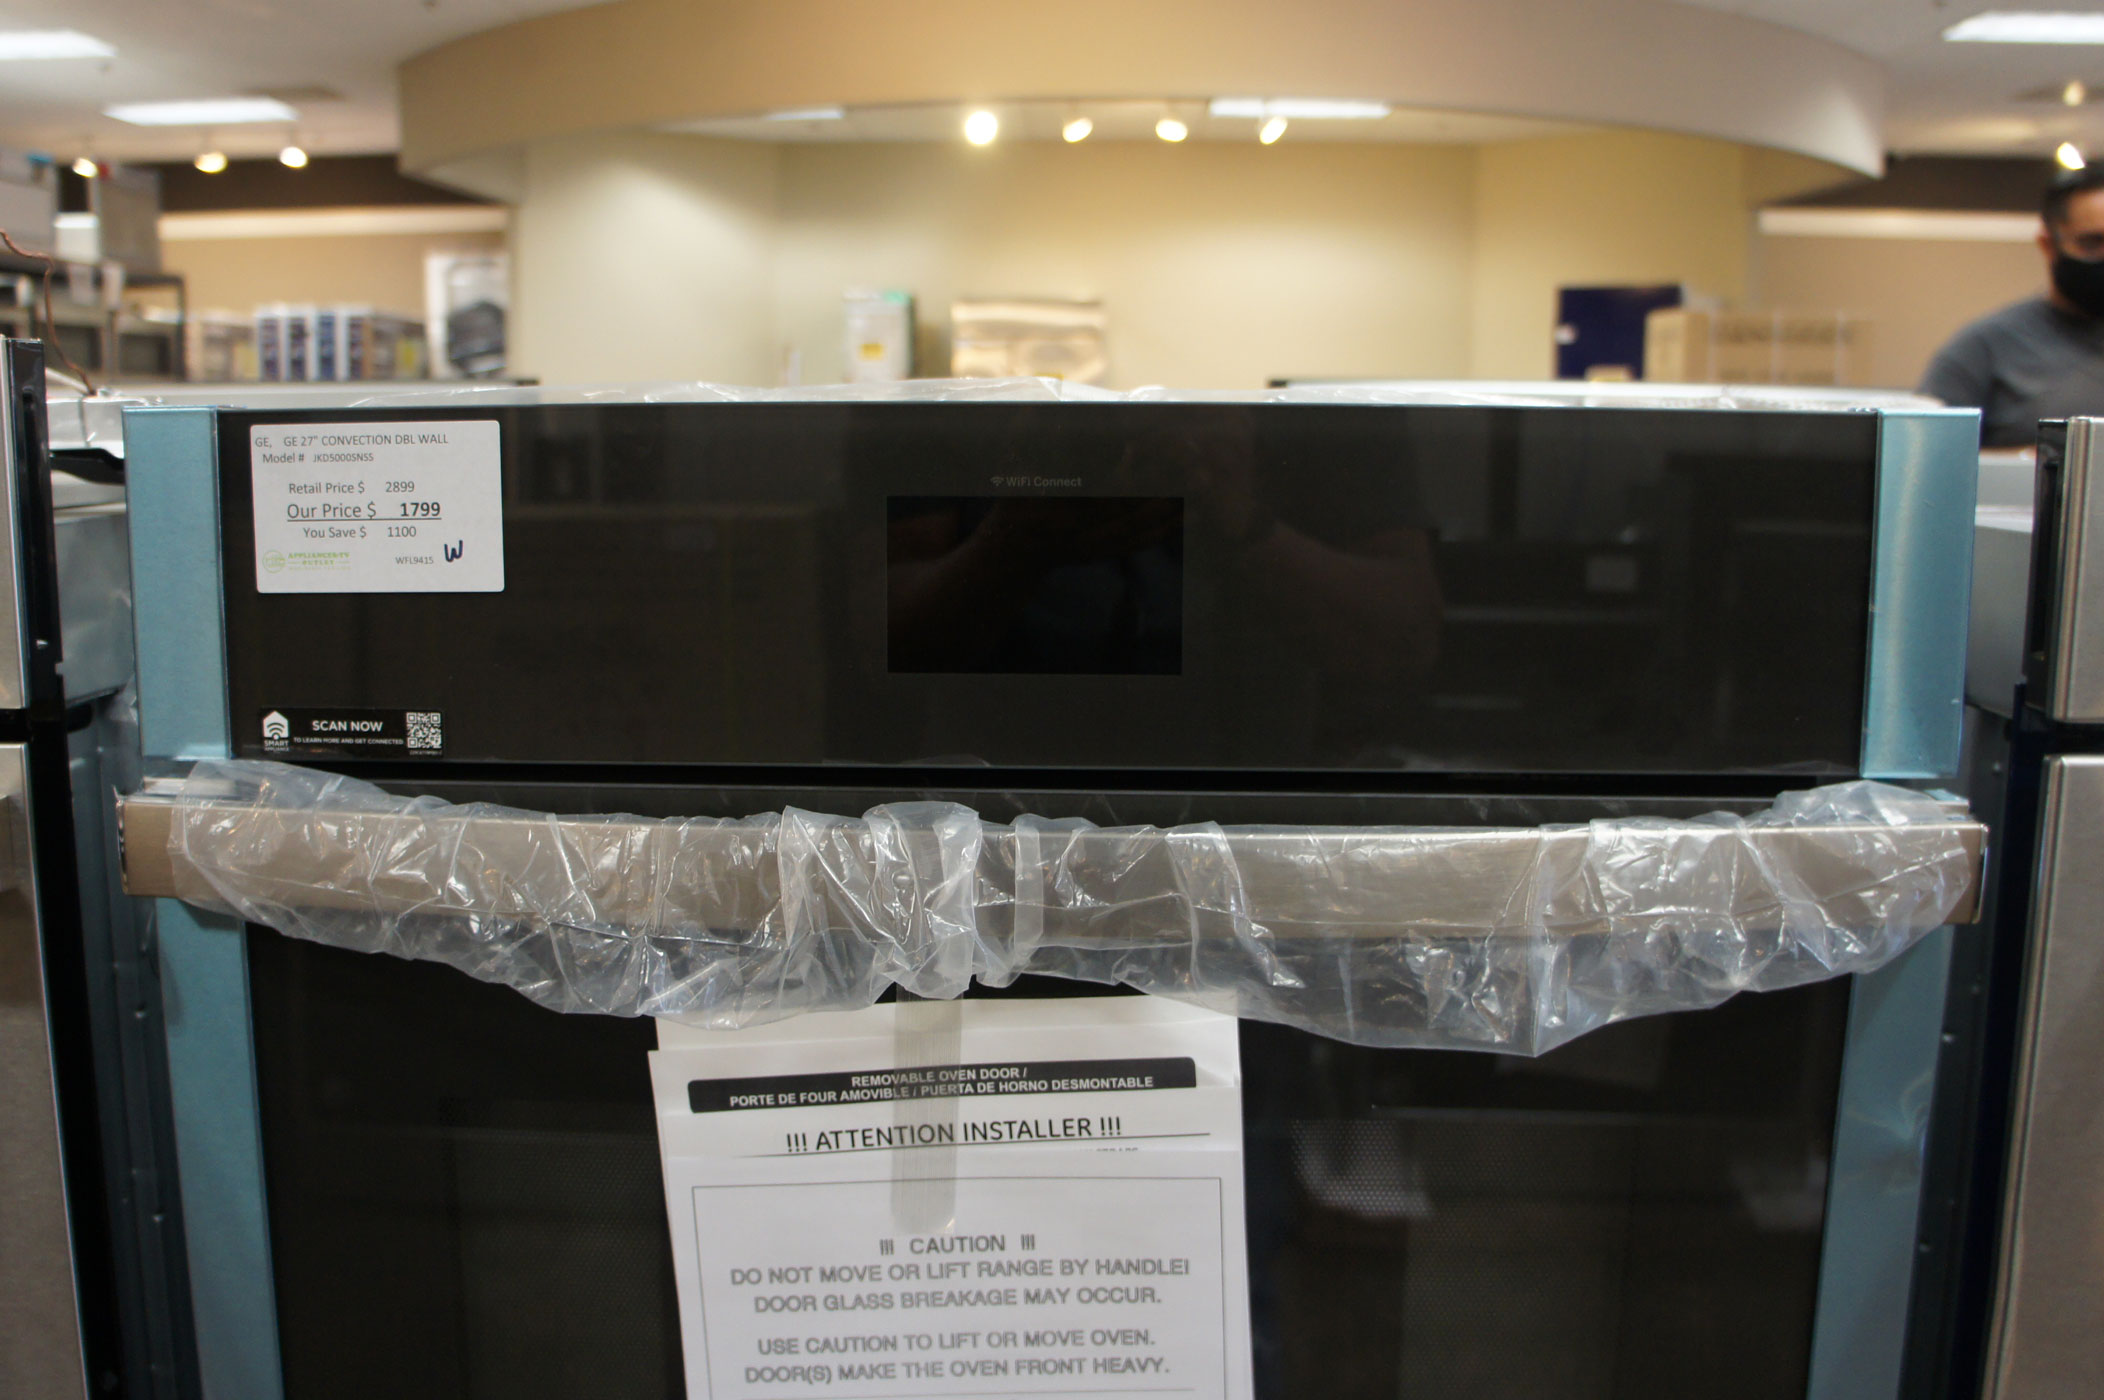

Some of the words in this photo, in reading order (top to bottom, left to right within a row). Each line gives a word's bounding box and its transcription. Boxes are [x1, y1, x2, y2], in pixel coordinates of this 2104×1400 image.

[255, 437, 272, 448] GE,
[283, 436, 298, 447] GE
[300, 435, 318, 447] 27"
[321, 434, 392, 446] CONVECTION
[395, 434, 416, 445] DBL
[418, 433, 449, 444] WALL
[262, 454, 296, 463] Model
[298, 453, 304, 463] #
[288, 483, 322, 494] Retail
[325, 483, 355, 494] Price
[357, 482, 366, 495] $
[385, 481, 415, 493] 2899
[1034, 476, 1082, 487] Connect
[287, 504, 316, 519] Our
[322, 502, 362, 518] Price
[367, 502, 377, 520] $
[400, 502, 441, 517] 1799
[303, 527, 325, 538] You
[328, 527, 357, 538] Save
[359, 525, 367, 539] $
[387, 526, 417, 538] 1100
[395, 556, 434, 565] WFL9415
[312, 720, 347, 731] SCAN
[350, 721, 383, 732] NOW
[851, 1071, 935, 1087] REMOVABLE
[938, 1069, 977, 1082] OVEN
[980, 1068, 1019, 1079] DOOR
[1023, 1067, 1028, 1078] /
[730, 1093, 775, 1107] PORTE
[778, 1093, 796, 1105] DE
[800, 1090, 836, 1104] FOUR
[839, 1087, 909, 1102] AMOVIBLE
[920, 1082, 974, 1096] PUERTA
[977, 1081, 996, 1093] DE
[999, 1079, 1048, 1092] HORNO
[1051, 1077, 1154, 1091] DESMONTABLE
[786, 1133, 808, 1153] !!!
[815, 1123, 955, 1151] ATTENTION
[963, 1117, 1092, 1141] INSTALLER
[1100, 1116, 1122, 1136] !!!
[909, 1235, 1006, 1255] CAUTION
[731, 1268, 762, 1285] DO
[769, 1267, 813, 1284] NOT
[819, 1264, 882, 1283] MOVE
[887, 1264, 921, 1281] OR
[926, 1262, 971, 1280] LIFT
[977, 1260, 1053, 1278] RANGE
[1059, 1259, 1089, 1276] BY
[754, 1295, 817, 1313] DOOR
[823, 1292, 895, 1311] GLASS
[900, 1289, 1017, 1308] BREAKAGE
[1023, 1287, 1071, 1305] MAY
[1076, 1287, 1162, 1304] OCCUR.
[757, 1338, 800, 1355] USE
[805, 1335, 898, 1354] CAUTION
[903, 1334, 933, 1350] TO
[938, 1332, 981, 1349] LIFT
[985, 1331, 1018, 1348] OR
[1023, 1330, 1085, 1347] MOVE
[1090, 1329, 1156, 1346] OVEN.
[744, 1365, 832, 1385] DOOR(S)
[838, 1363, 897, 1380] MAKE
[901, 1361, 944, 1378] THE
[949, 1359, 1008, 1377] OVEN
[1014, 1358, 1087, 1376] FRONT
[1092, 1357, 1171, 1374] HEAVY.
